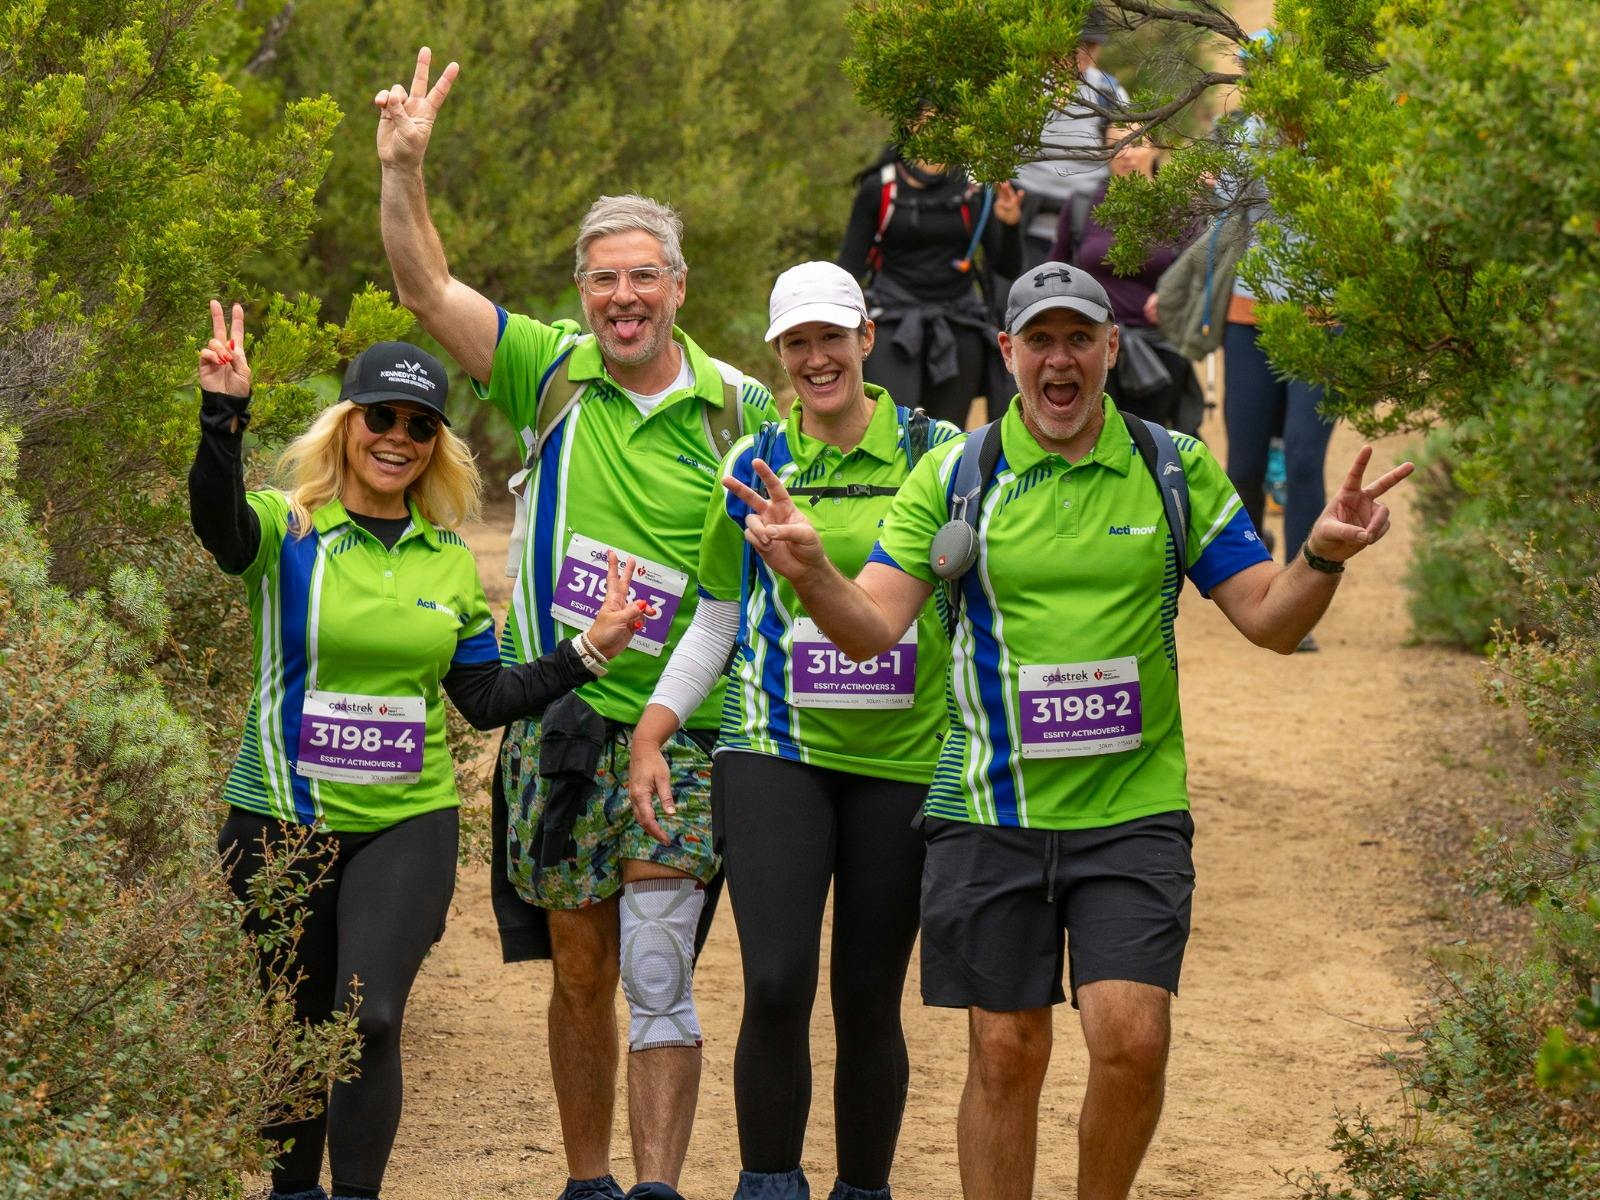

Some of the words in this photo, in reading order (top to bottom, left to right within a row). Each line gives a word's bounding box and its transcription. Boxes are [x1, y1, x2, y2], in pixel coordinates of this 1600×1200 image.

[380, 370, 417, 381] KENNEDY'S
[570, 600, 595, 614] ESSITY
[1042, 670, 1089, 682] coastrek
[813, 682, 839, 690] ESSITY
[328, 702, 373, 713] coastrek
[1031, 690, 1132, 723] 3198-2
[309, 722, 416, 753] 3198-4
[1043, 730, 1070, 739] ESSITY
[1071, 726, 1120, 737] ACTIMOVERS
[320, 754, 346, 765] ESSITY
[347, 758, 396, 768] ACTIMOVERS
